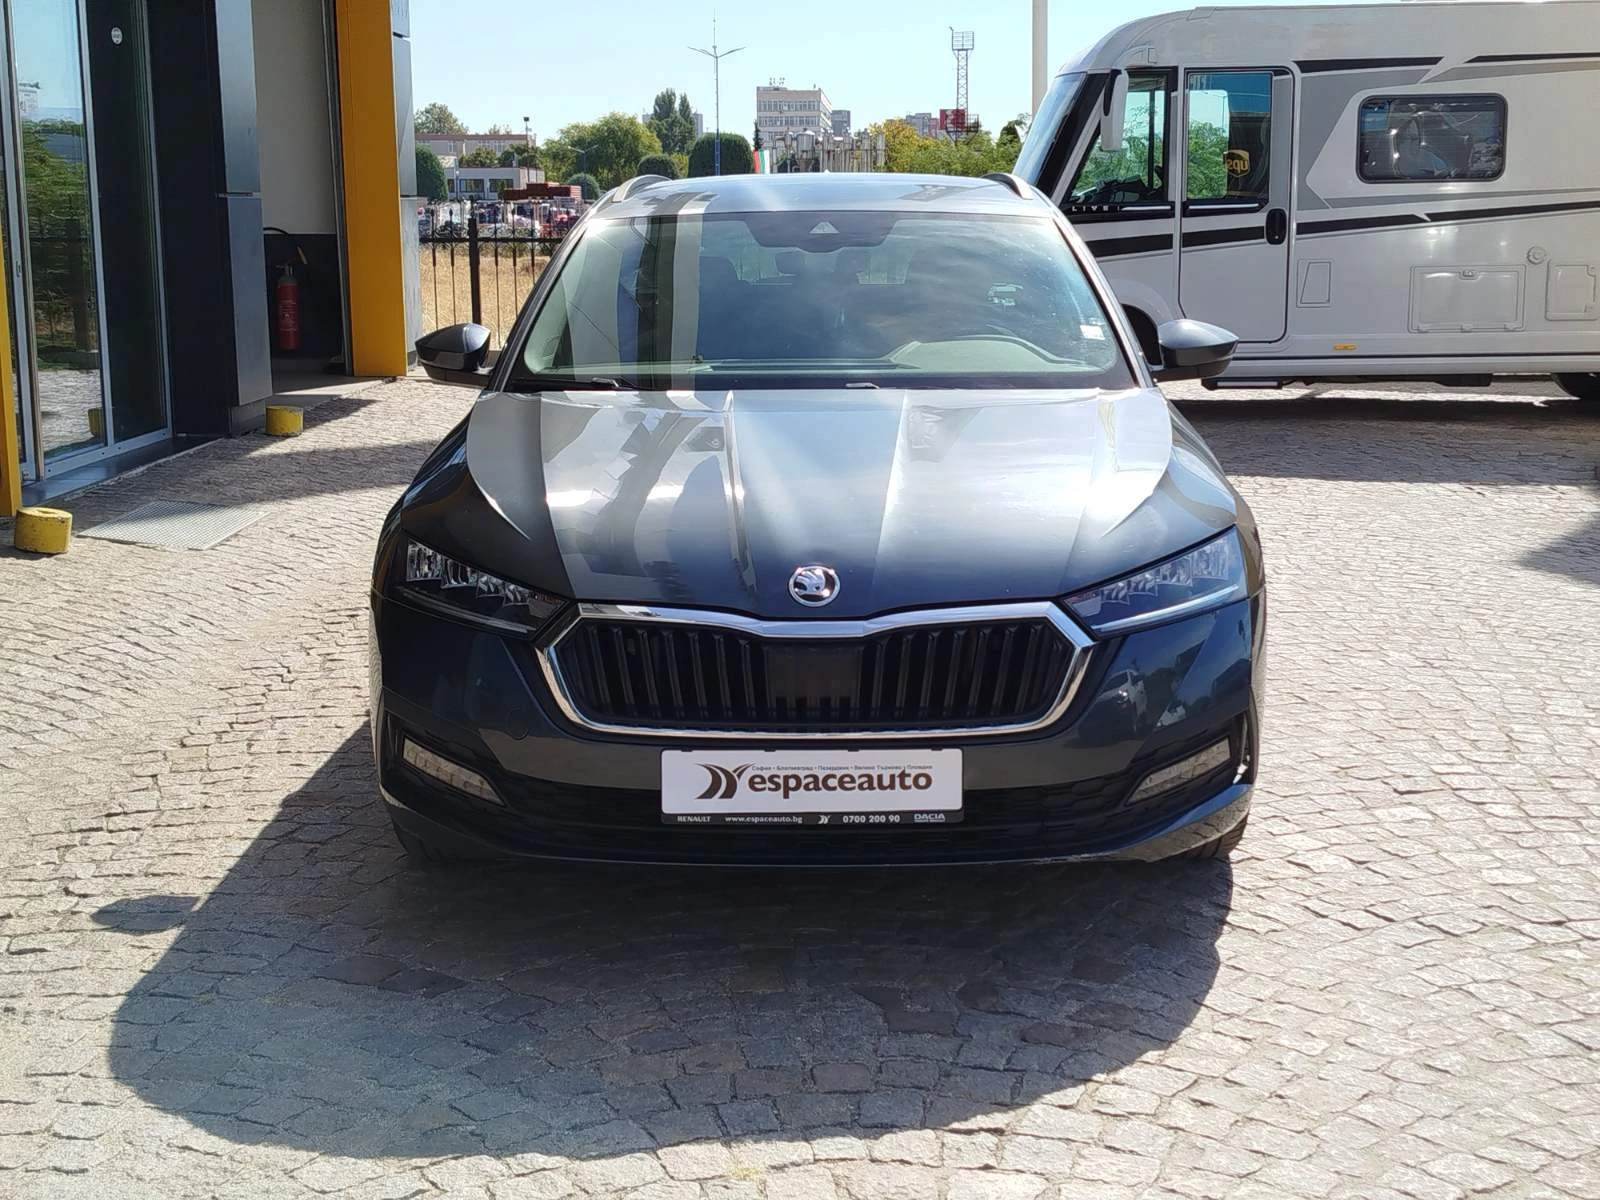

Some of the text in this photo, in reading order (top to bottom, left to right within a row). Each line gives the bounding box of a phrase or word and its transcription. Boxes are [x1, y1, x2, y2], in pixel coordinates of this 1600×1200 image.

[748, 768, 933, 799] espaceauto
[677, 815, 711, 823] RENAULT
[725, 815, 803, 824] www.espaceauto.bg
[842, 813, 901, 823] 0700 200 90
[913, 812, 945, 820] DACIA
